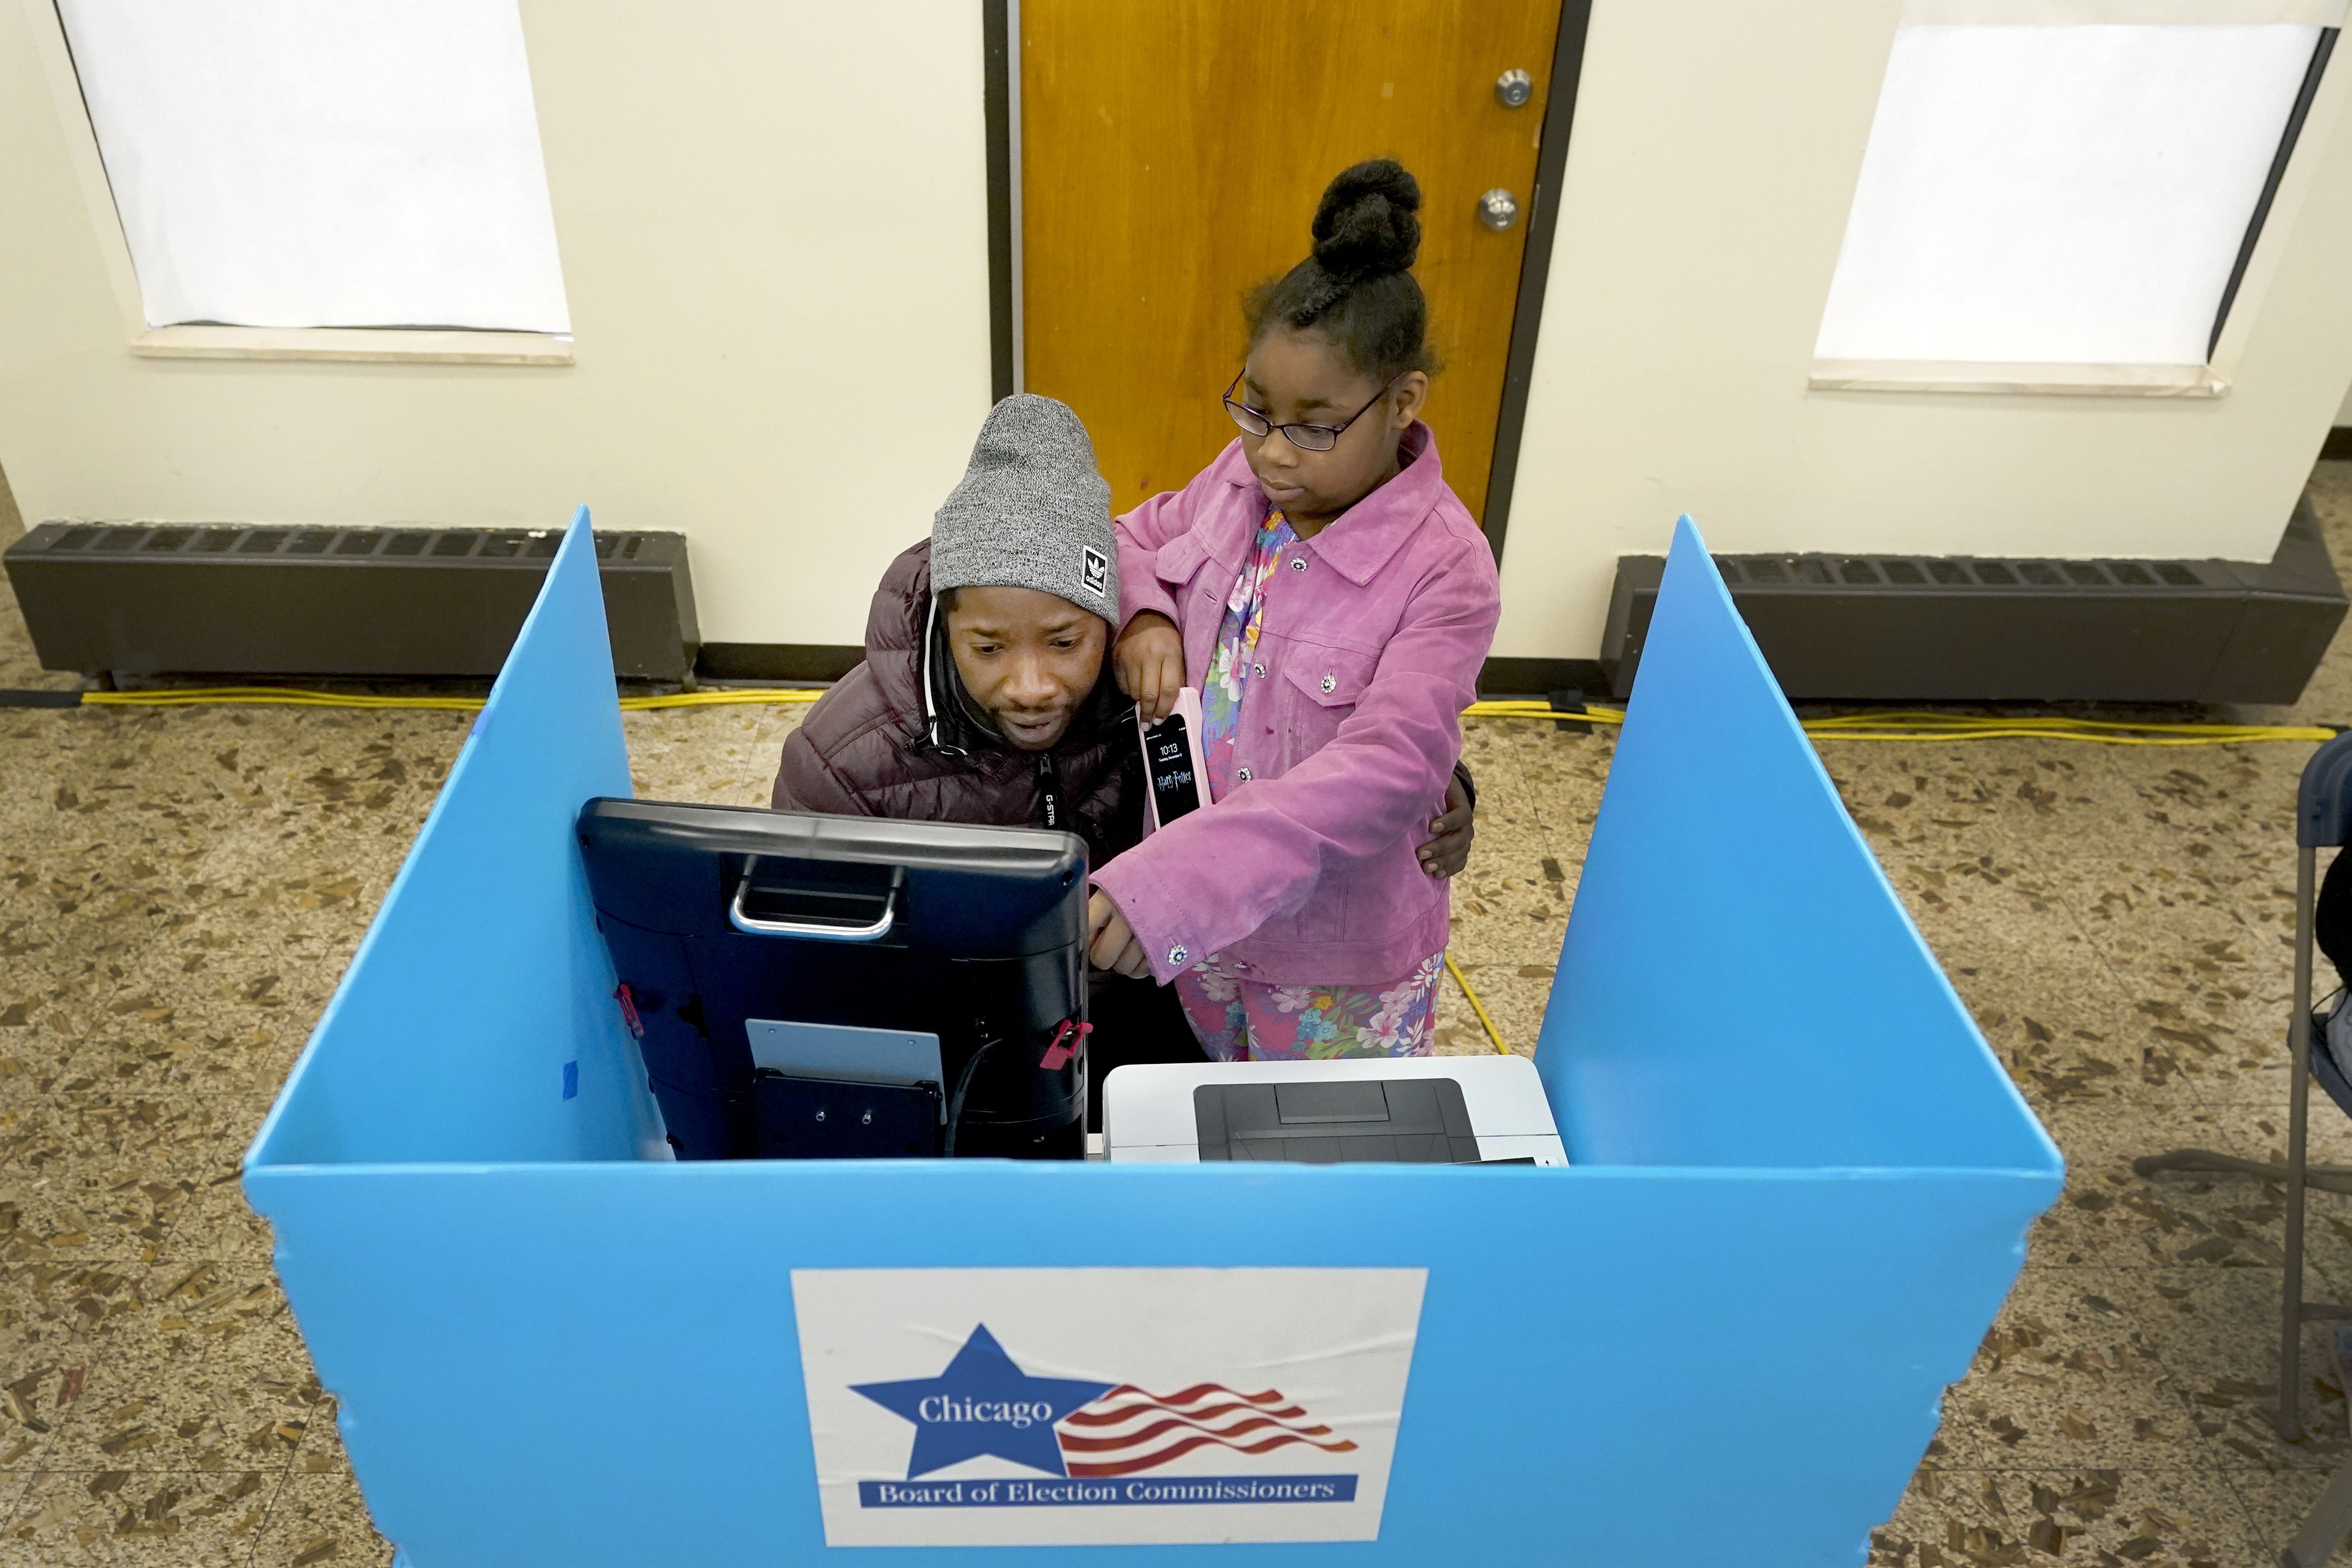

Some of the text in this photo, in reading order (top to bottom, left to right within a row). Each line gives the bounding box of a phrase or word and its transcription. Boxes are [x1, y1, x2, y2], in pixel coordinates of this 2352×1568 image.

[1086, 575, 1102, 589] adidas
[1160, 743, 1178, 755] 10:13
[1157, 771, 1191, 792] Harry Potter
[918, 1393, 1053, 1429] Chicago
[879, 1480, 1335, 1504] Board of Election Commissioners
